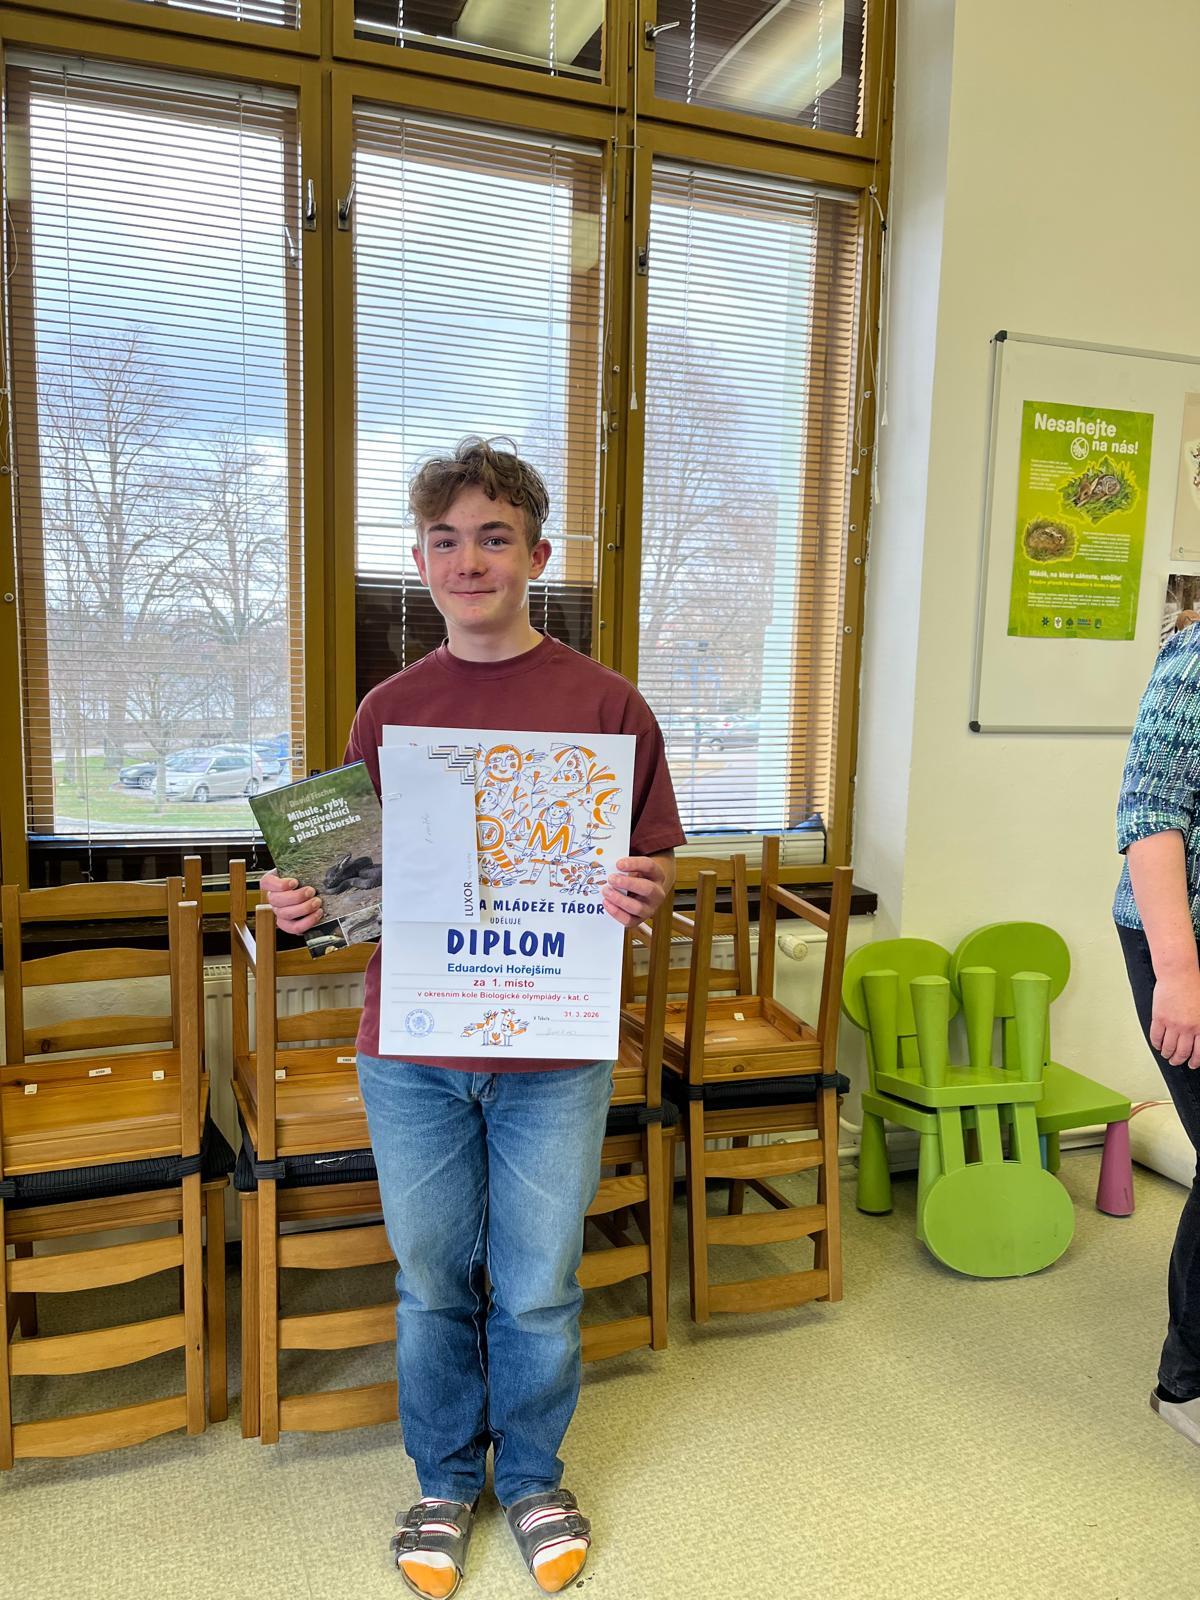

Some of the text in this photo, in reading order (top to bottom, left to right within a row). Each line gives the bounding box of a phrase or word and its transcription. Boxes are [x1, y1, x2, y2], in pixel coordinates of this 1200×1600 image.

[1034, 412, 1117, 440] Nesahejte
[1092, 440, 1139, 455] na nás!
[287, 797, 348, 822] Mihule, ryby,
[292, 805, 350, 831] obojživelníci
[288, 814, 361, 844] a plazi Táborska
[463, 881, 474, 917] LUXOR
[493, 898, 555, 913] MLÁDEŽE
[560, 900, 605, 915] TÁBOR
[489, 916, 521, 925] UDĚLUJE
[447, 928, 565, 958] DIPLOM
[447, 963, 562, 976] Eduardovi Hořejšímu
[473, 978, 535, 989] za 1. místo
[479, 991, 520, 1001] Biologické
[521, 993, 561, 1001] olympiády
